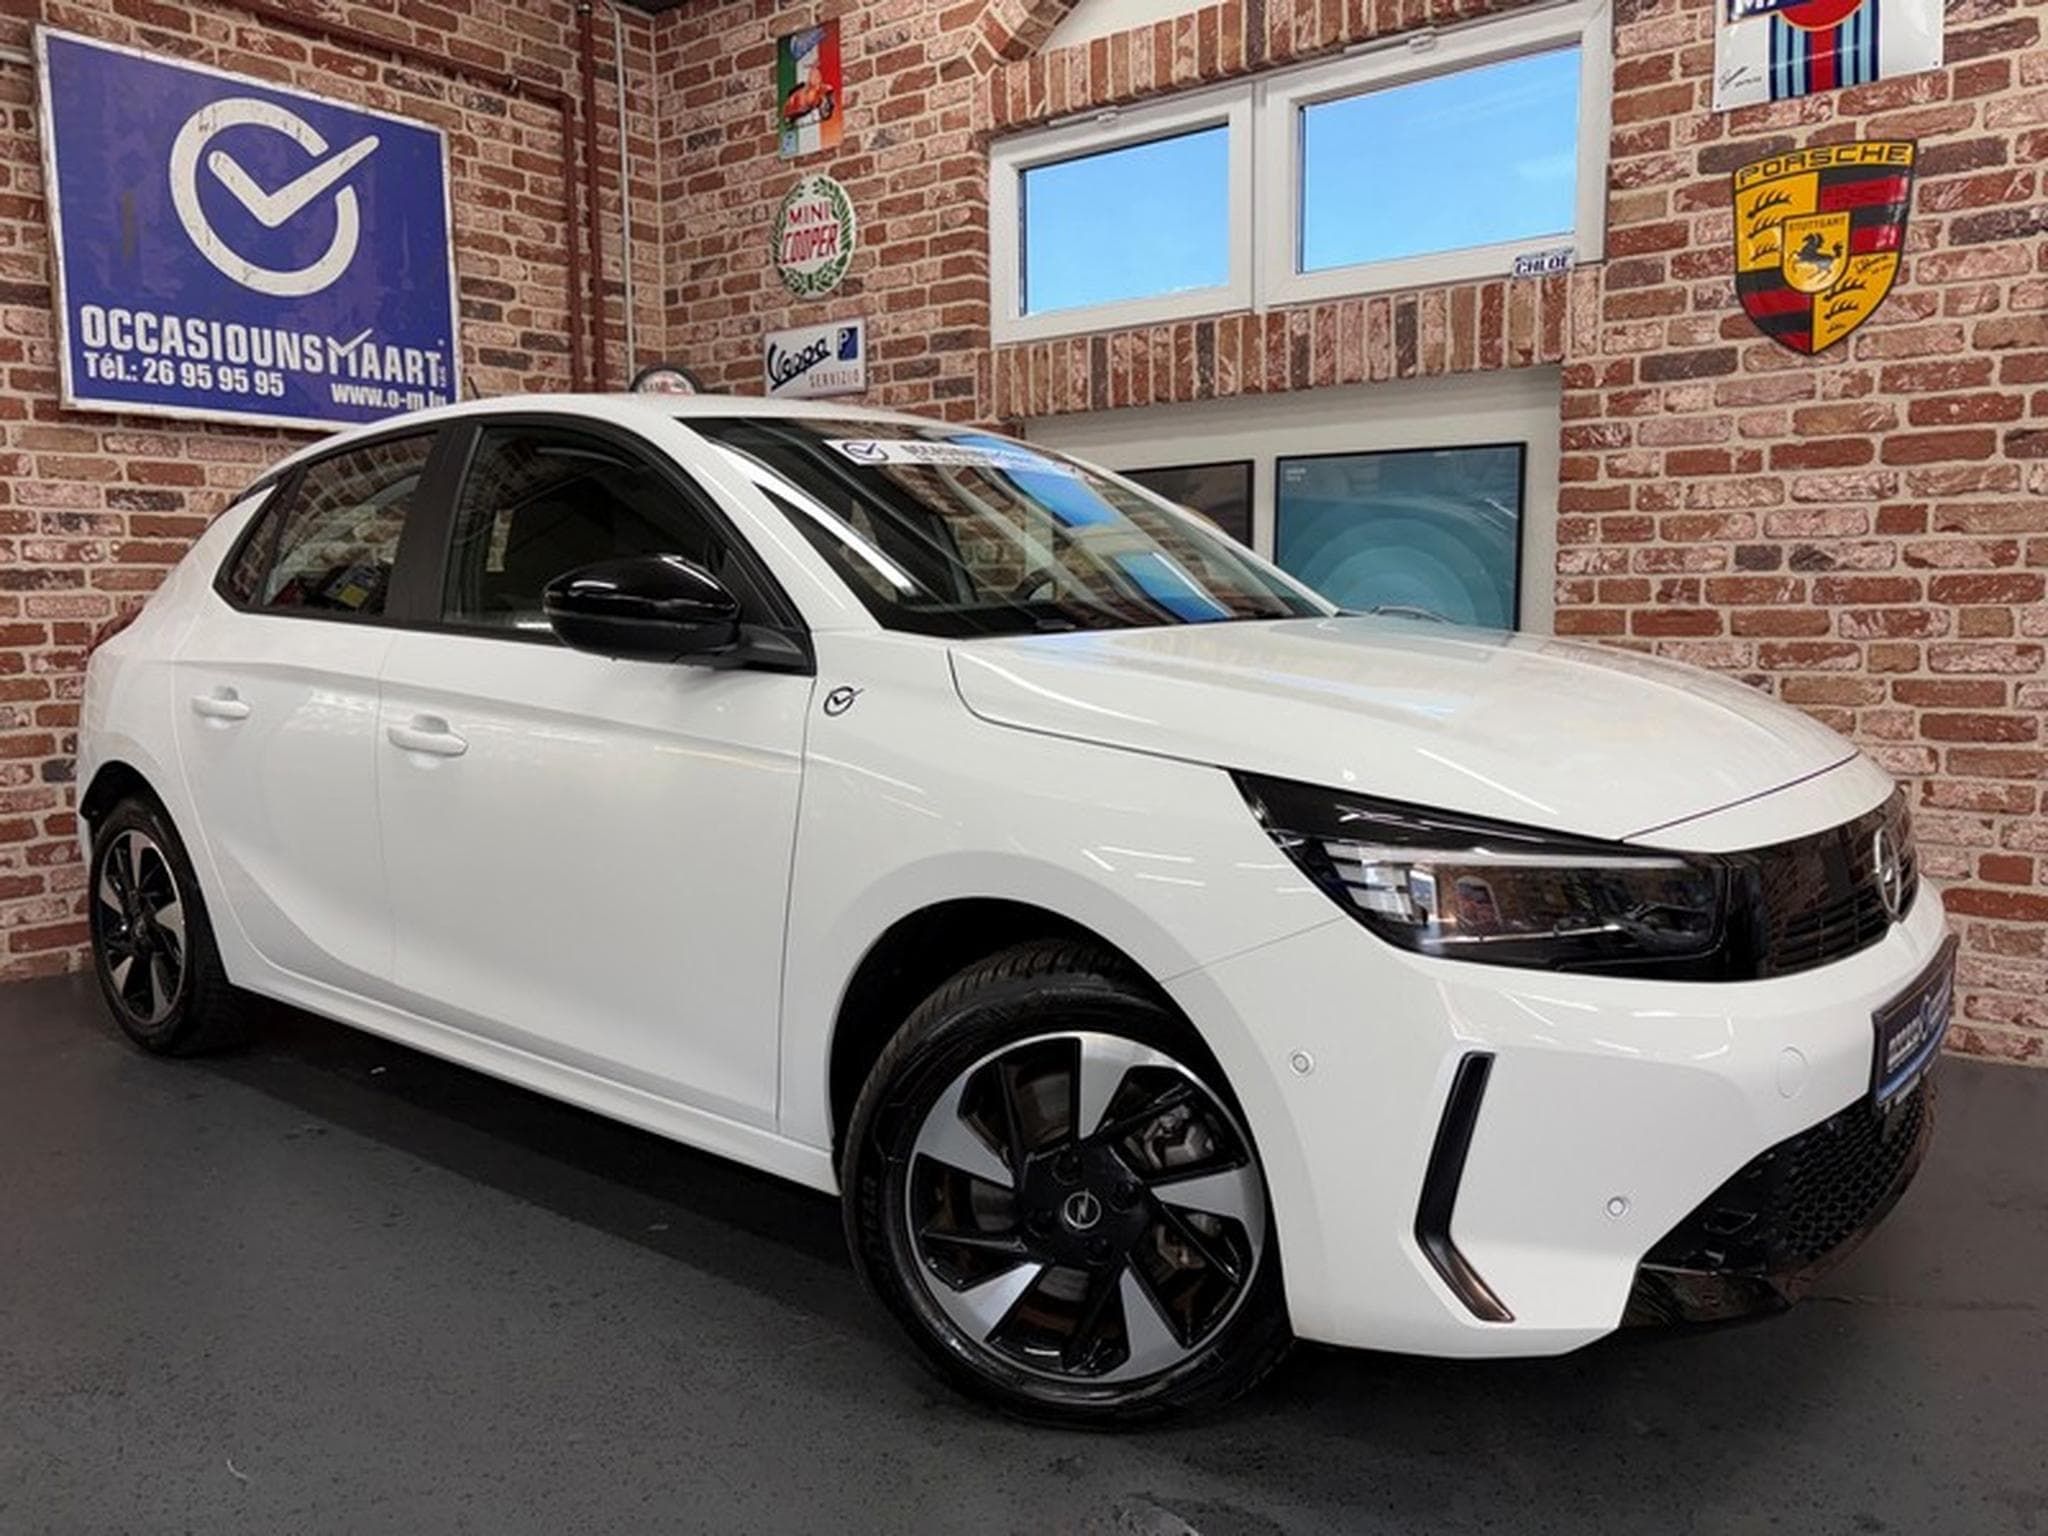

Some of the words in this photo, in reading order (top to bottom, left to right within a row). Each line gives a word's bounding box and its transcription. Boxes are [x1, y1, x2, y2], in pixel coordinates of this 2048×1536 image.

[1738, 144, 1909, 186] PORSCHE
[787, 200, 830, 225] MINI
[781, 223, 839, 265] COOPER
[142, 357, 175, 386] 26
[180, 361, 213, 390] 95
[218, 366, 249, 393] 95
[254, 370, 285, 397] 95
[767, 338, 831, 391] Vespa
